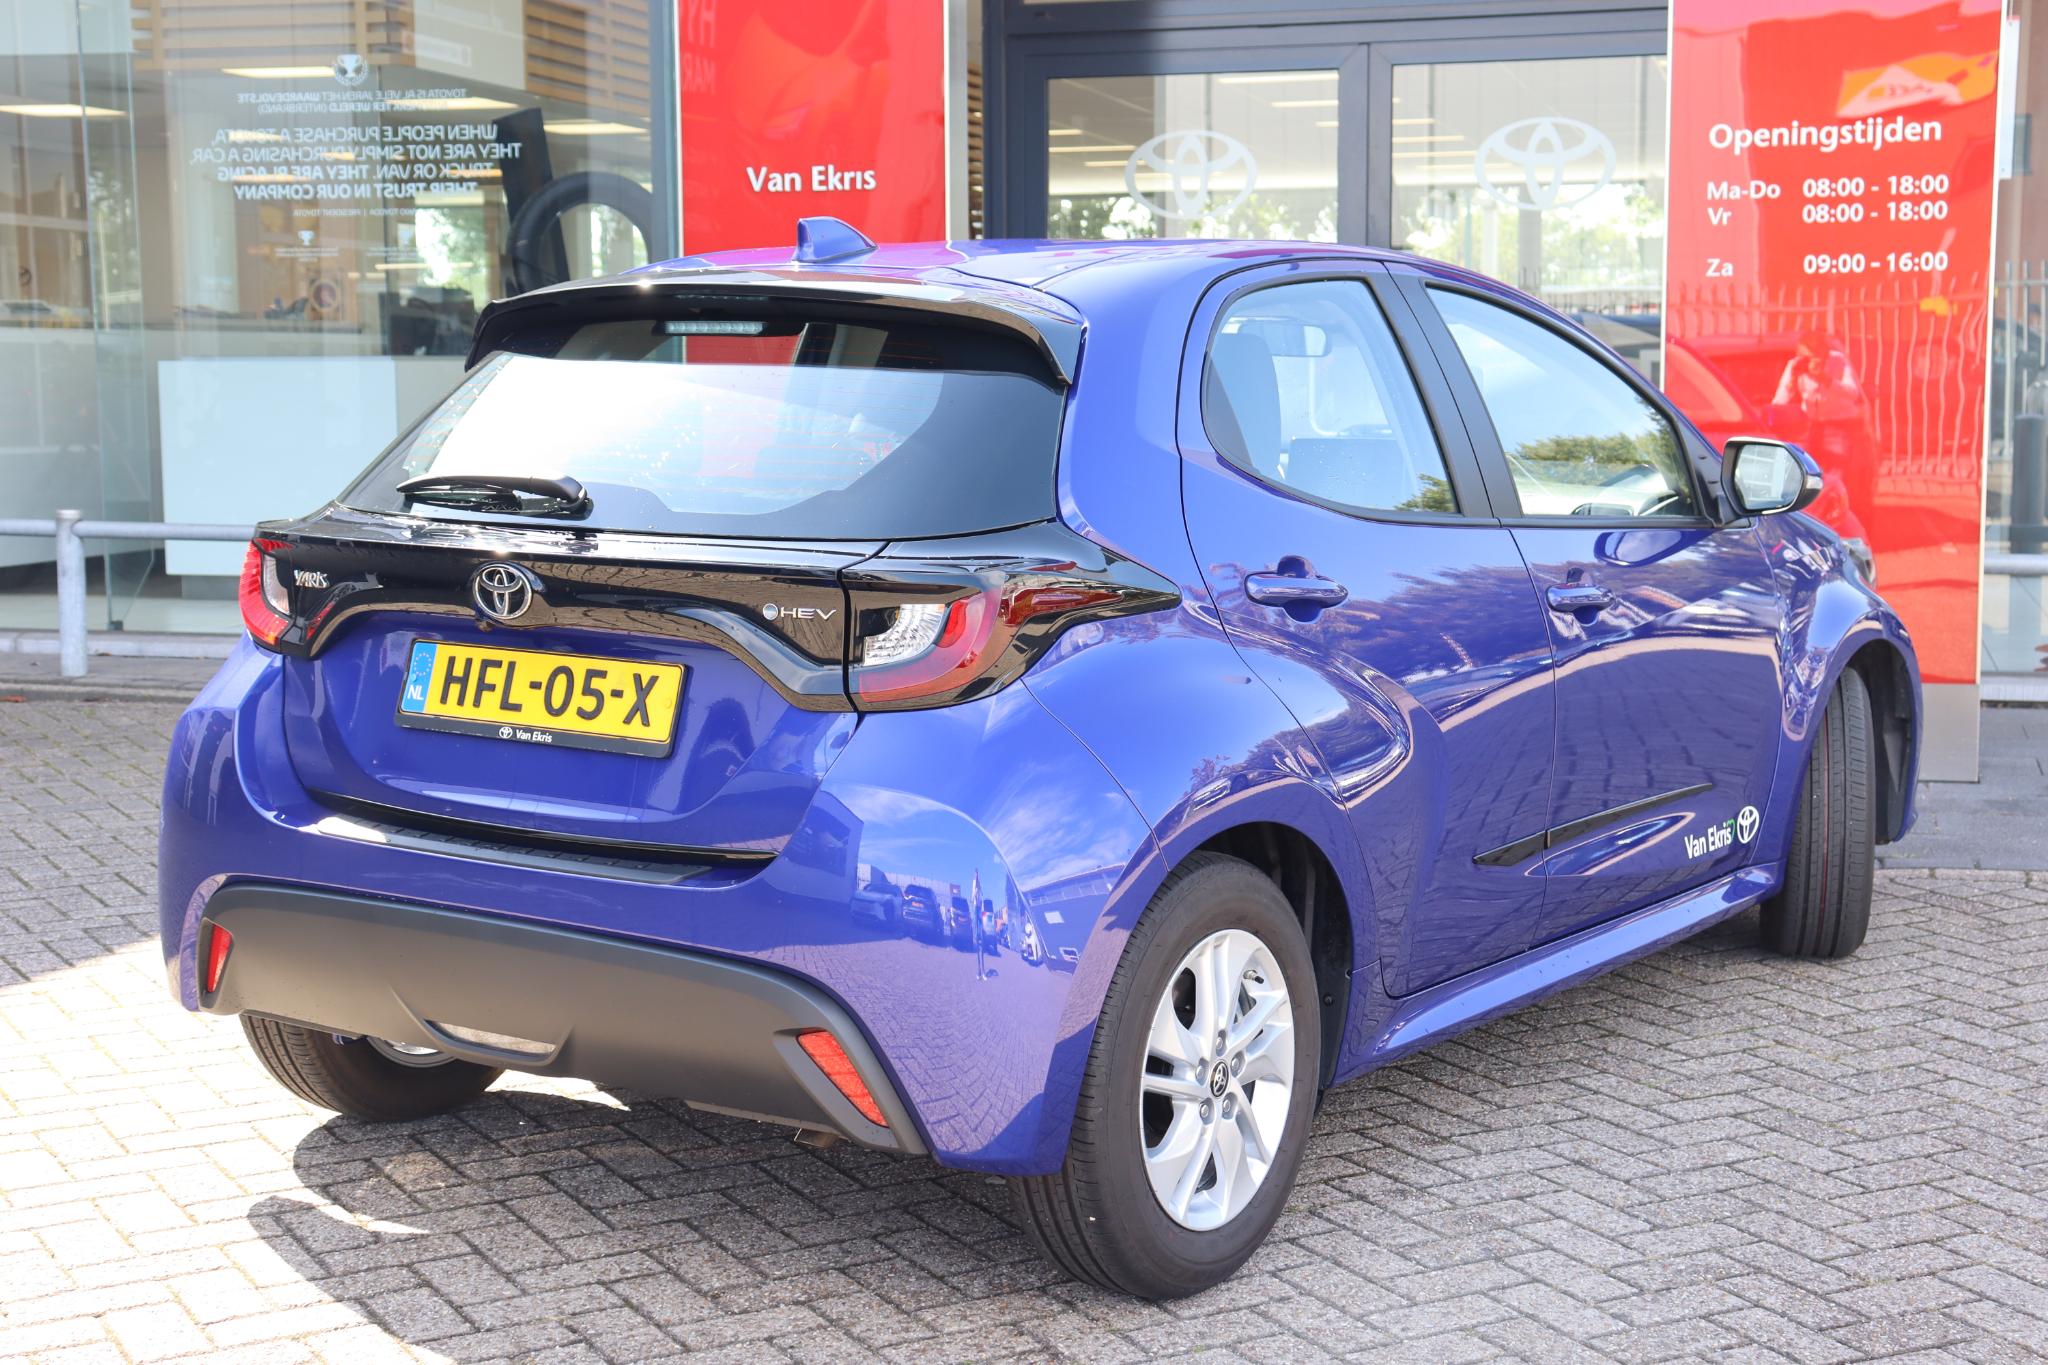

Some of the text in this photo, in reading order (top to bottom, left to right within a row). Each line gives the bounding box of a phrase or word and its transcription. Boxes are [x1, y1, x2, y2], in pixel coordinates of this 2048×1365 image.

[1708, 115, 1942, 156] Openingstijden
[745, 164, 877, 192] Van Ekris
[1706, 180, 1781, 200] Ma-Do
[1802, 177, 1865, 198] 08:00
[1887, 174, 1950, 195] 18:00
[1706, 207, 1732, 226] Vr
[1802, 203, 1864, 224] 08:00
[1886, 200, 1949, 221] 18:00
[1705, 258, 1734, 277] Za
[1803, 253, 1866, 274] 09:00
[1886, 252, 1949, 273] 16:00
[293, 569, 330, 589] YARIS
[780, 606, 837, 620] HEV
[407, 684, 425, 701] NL
[439, 655, 660, 728] HFL-05-X
[516, 729, 553, 743] Van Ekris
[1684, 822, 1732, 859] Van Ekris
